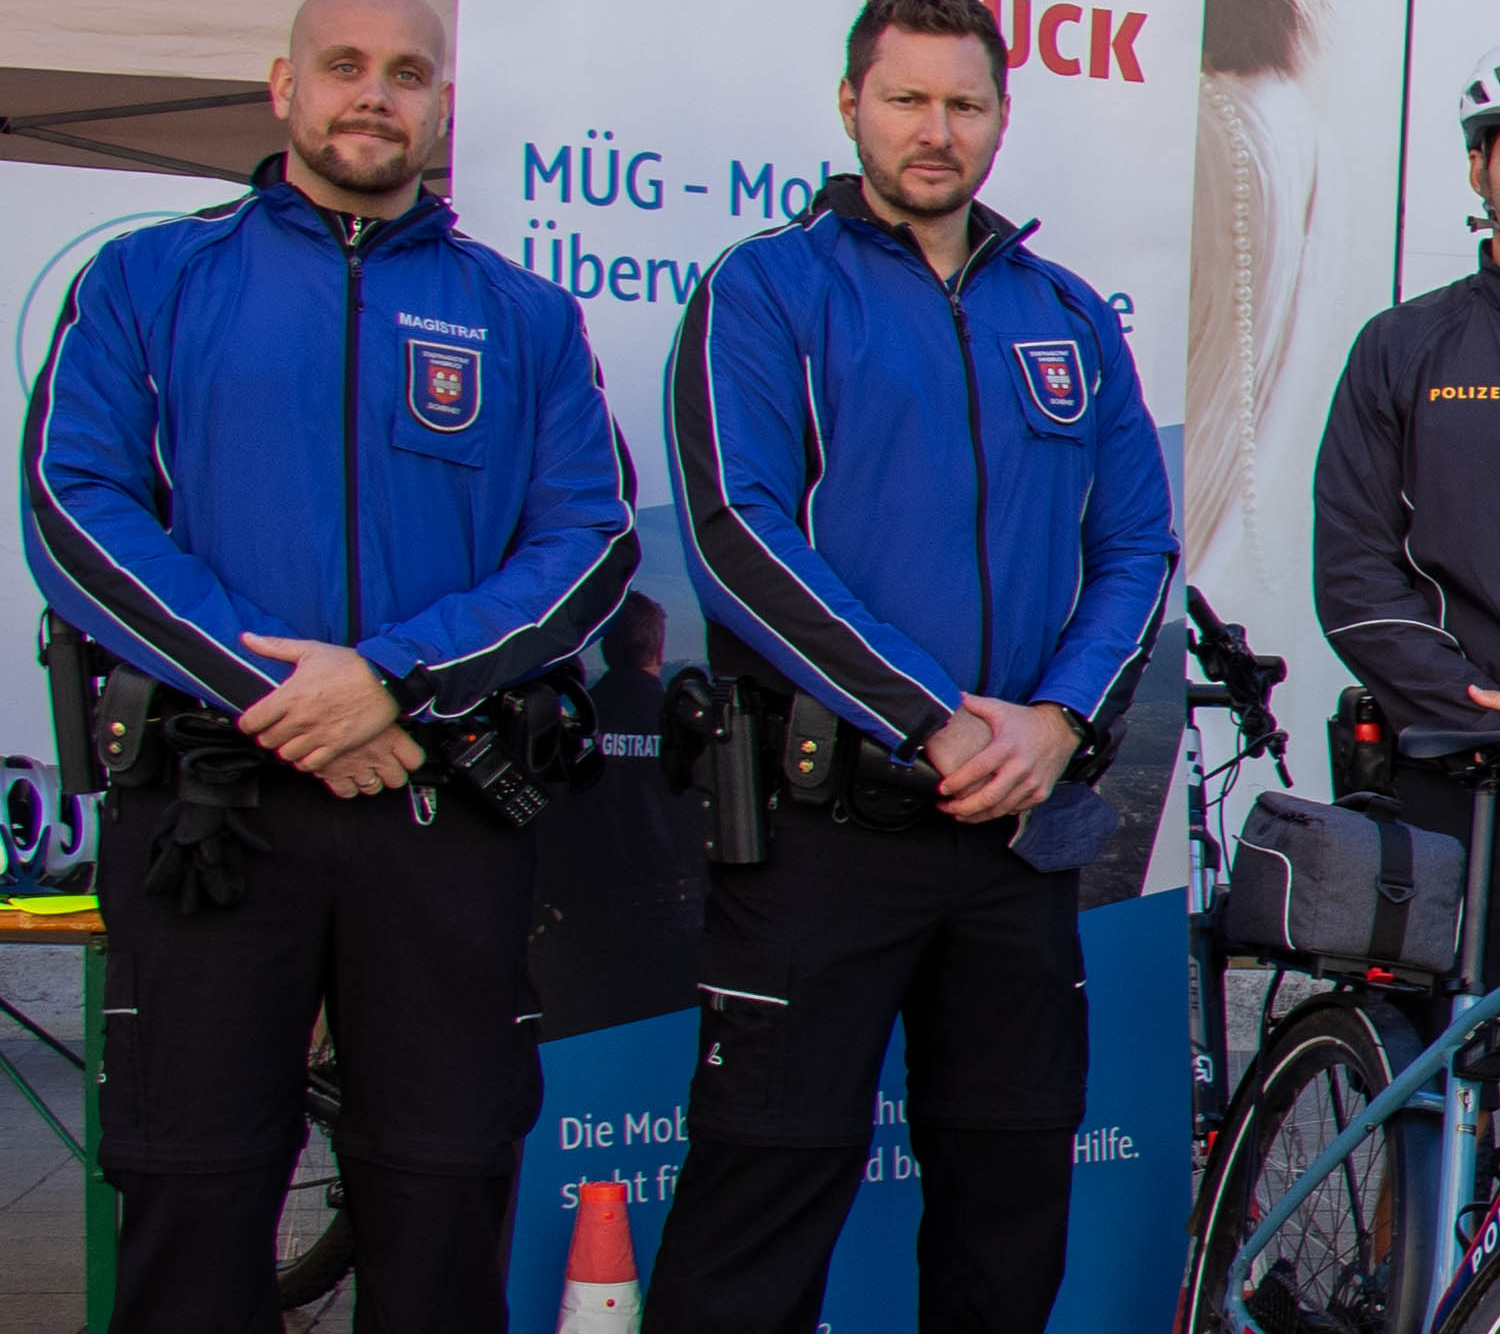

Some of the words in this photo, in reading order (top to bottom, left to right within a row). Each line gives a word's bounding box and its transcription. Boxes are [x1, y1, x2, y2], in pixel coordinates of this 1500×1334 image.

[522, 129, 666, 211] MÜG
[397, 311, 489, 341] MAGISTRAT
[560, 1113, 615, 1151] Die
